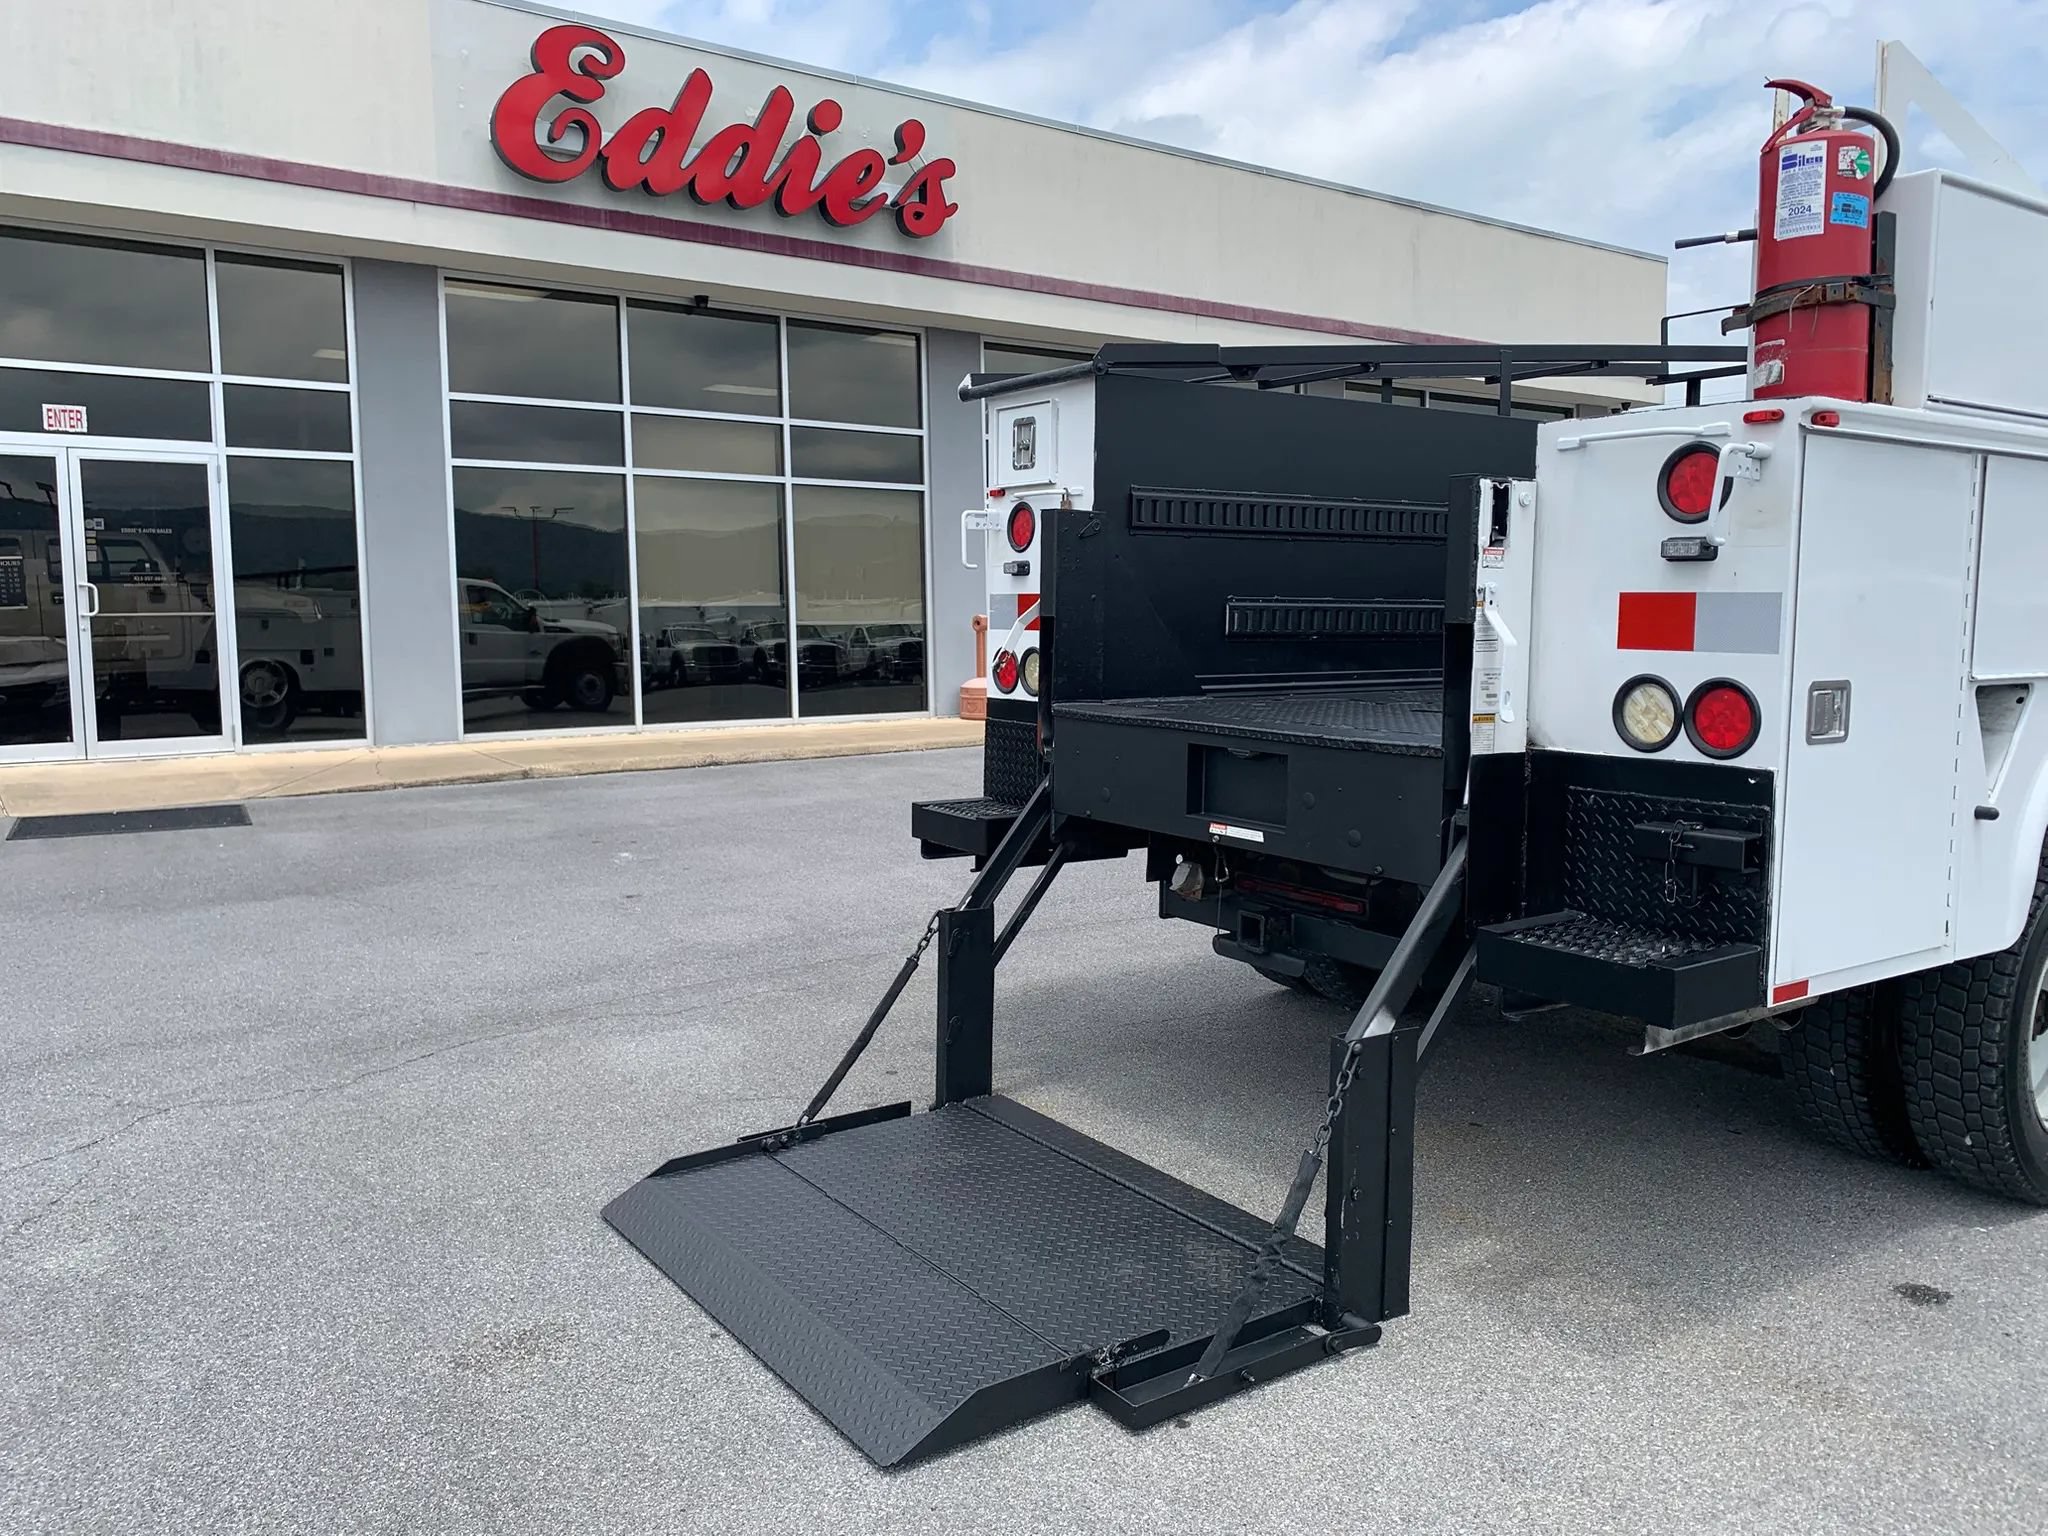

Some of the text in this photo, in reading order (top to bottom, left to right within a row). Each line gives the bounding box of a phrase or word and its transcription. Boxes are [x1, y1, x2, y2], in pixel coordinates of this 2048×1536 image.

[490, 25, 958, 238] Eddie's
[1781, 153, 1824, 171] Silco
[1788, 204, 1812, 217] 2024
[47, 408, 83, 428] ENTER
